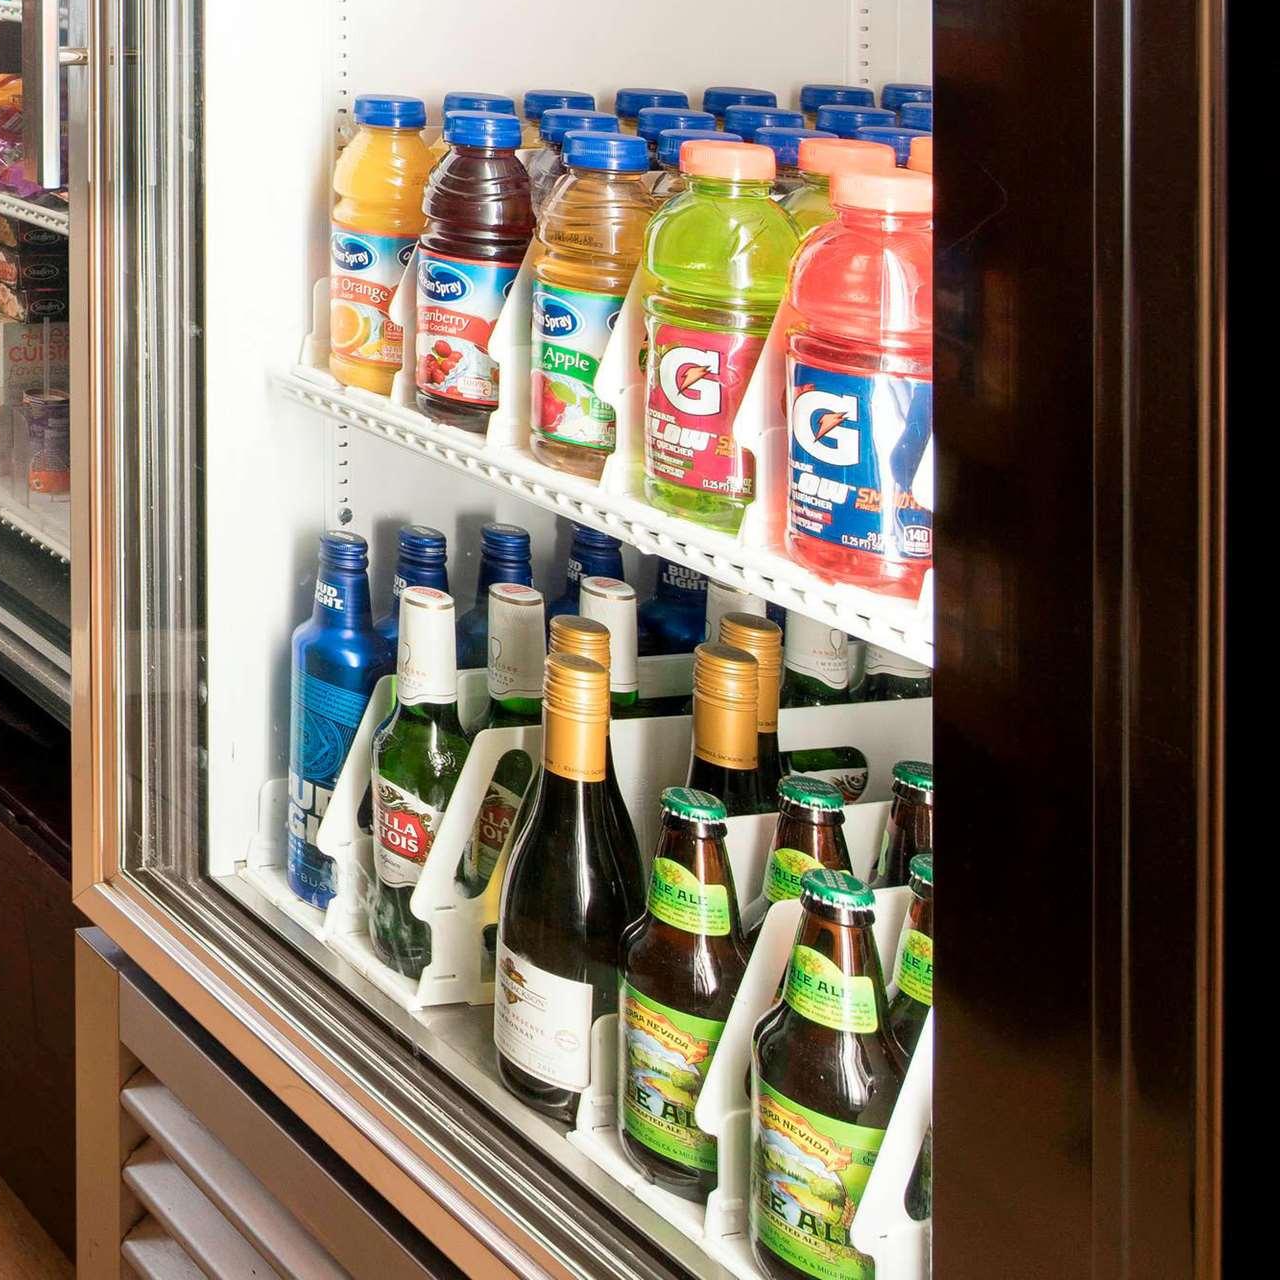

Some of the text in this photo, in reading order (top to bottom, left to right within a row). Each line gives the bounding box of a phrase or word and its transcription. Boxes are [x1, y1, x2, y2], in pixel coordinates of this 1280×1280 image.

[343, 250, 369, 267] Spray
[342, 279, 389, 304] Orange
[435, 280, 463, 297] Spray
[545, 313, 573, 332] Spray
[544, 346, 591, 372] Apple
[659, 346, 722, 417] G
[793, 390, 861, 470] G
[841, 534, 859, 546] (1.25
[908, 530, 928, 542] 140
[662, 573, 708, 592] LIGHT
[668, 564, 703, 581] BUD
[377, 809, 418, 839] ELLA
[380, 825, 419, 855] TOIS
[676, 887, 709, 908] ALE
[645, 1017, 690, 1052] NEVADA
[661, 1098, 698, 1128] AL
[782, 1119, 831, 1156] NEVADA
